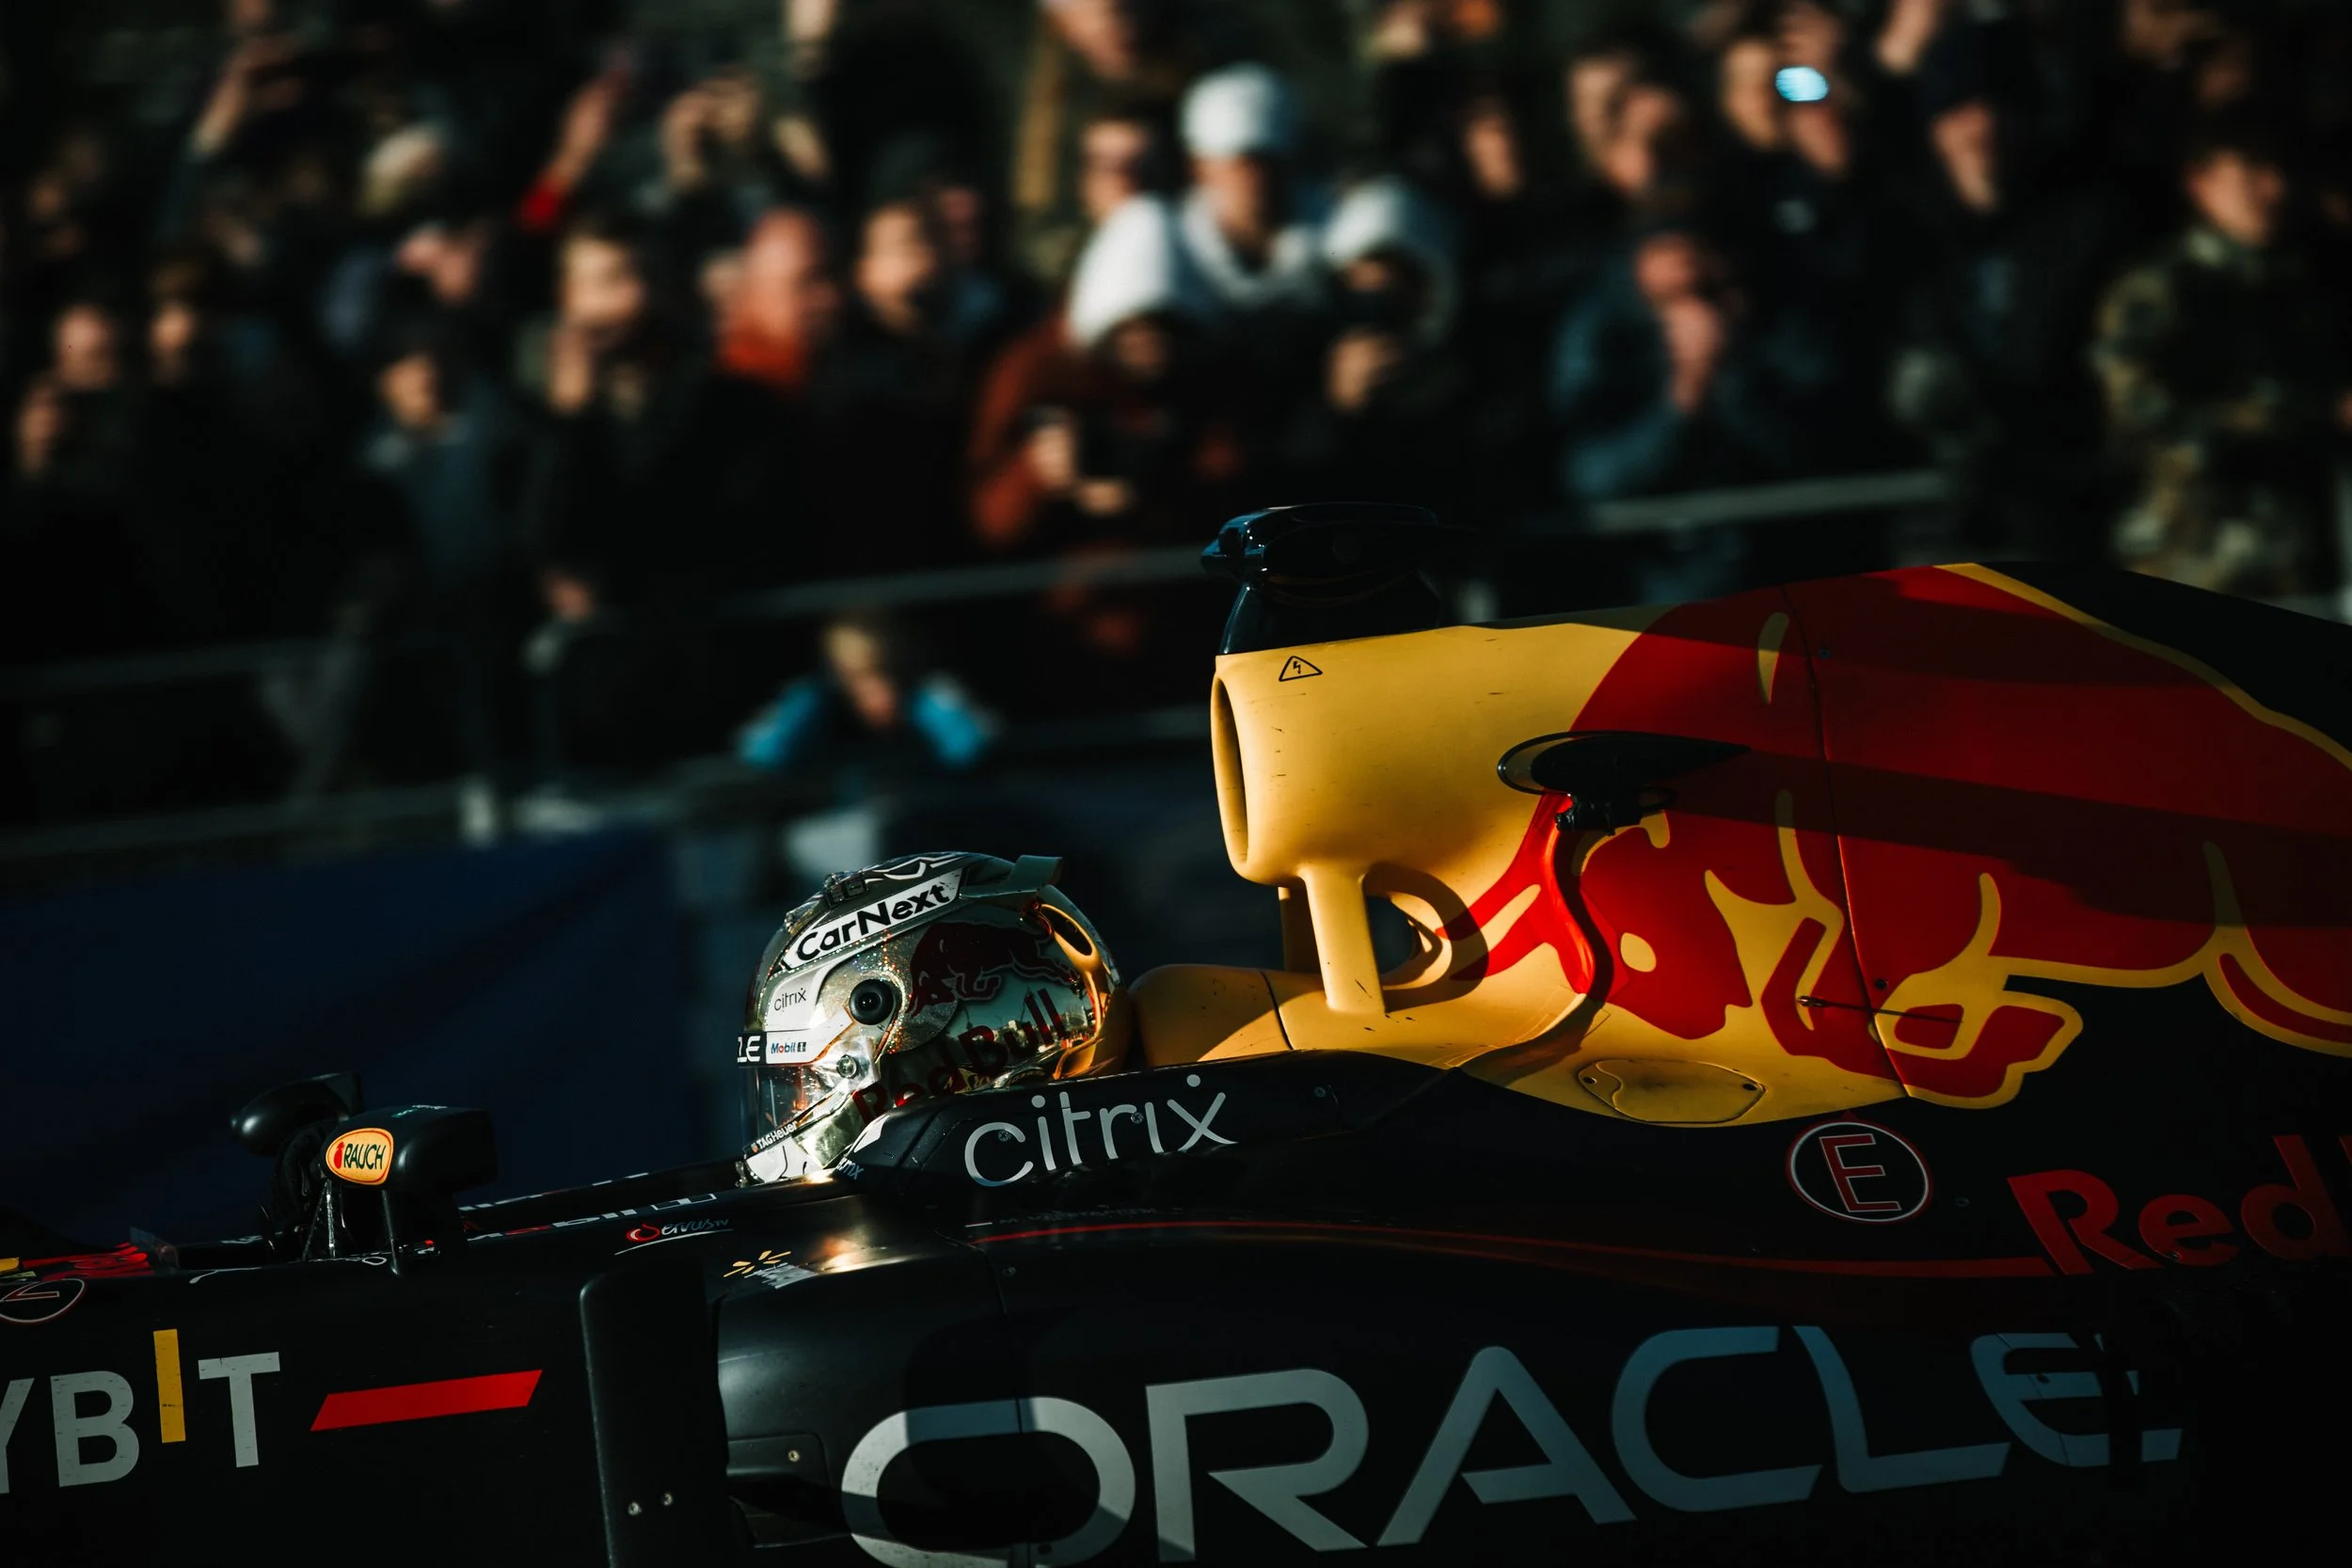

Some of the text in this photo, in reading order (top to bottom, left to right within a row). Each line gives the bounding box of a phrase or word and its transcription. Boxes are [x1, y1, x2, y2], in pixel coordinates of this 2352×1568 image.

[797, 882, 950, 961] CarNext
[774, 988, 806, 1011] citrix
[959, 988, 1066, 1076] Bull
[771, 1042, 797, 1054] Mobil
[342, 1143, 386, 1171] RAUCH
[964, 1073, 1239, 1187] citrix
[1819, 1132, 1902, 1213] E
[2006, 1133, 2352, 1276] Red
[841, 1324, 2183, 1568] ORACLE
